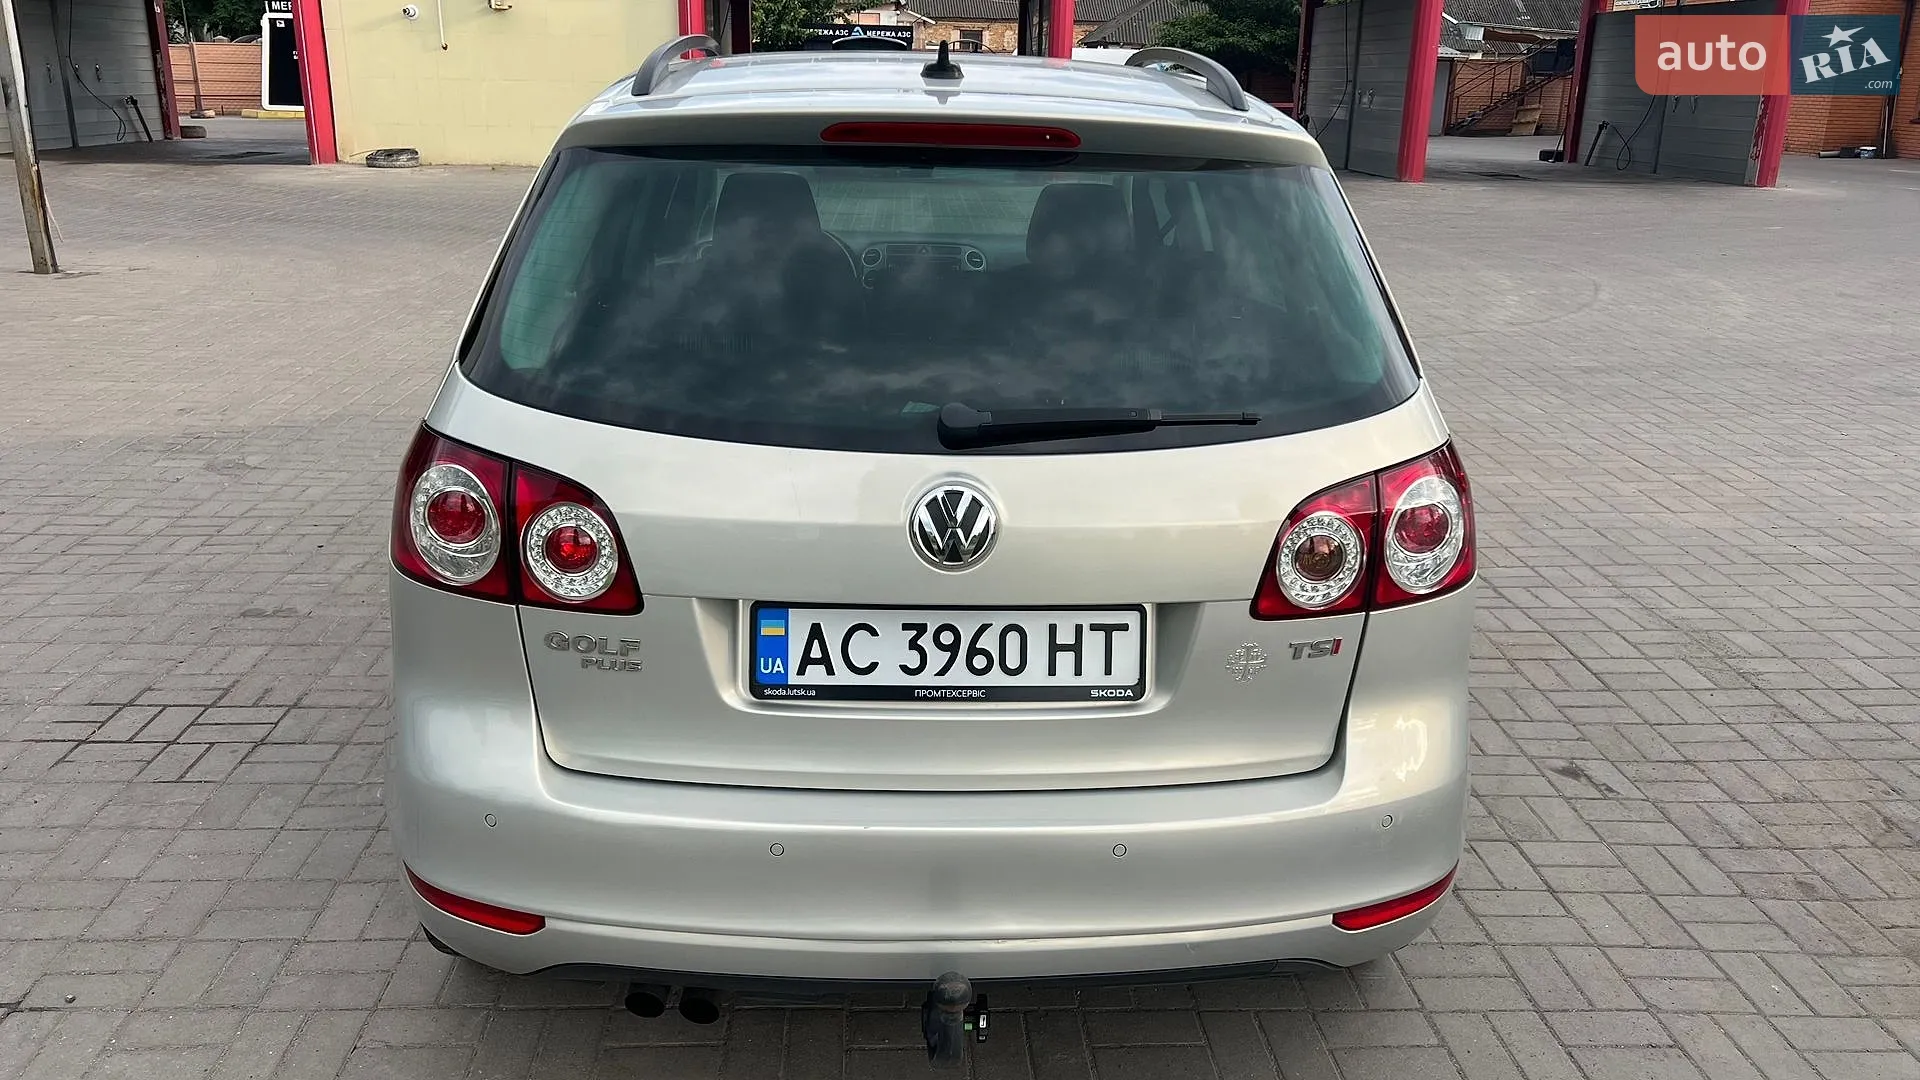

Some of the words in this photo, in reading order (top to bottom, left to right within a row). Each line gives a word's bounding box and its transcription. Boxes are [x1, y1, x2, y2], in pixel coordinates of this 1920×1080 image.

[543, 630, 641, 657] GOLF
[796, 622, 880, 676] AC
[898, 622, 1028, 677] 3960
[1047, 622, 1130, 677] HT
[1289, 637, 1343, 660] TSI
[581, 657, 642, 672] PLUS
[760, 658, 785, 674] UA
[763, 687, 816, 697] skoda.lutsk.ua
[914, 689, 986, 698] ПРОМТЕХСЕРВІС
